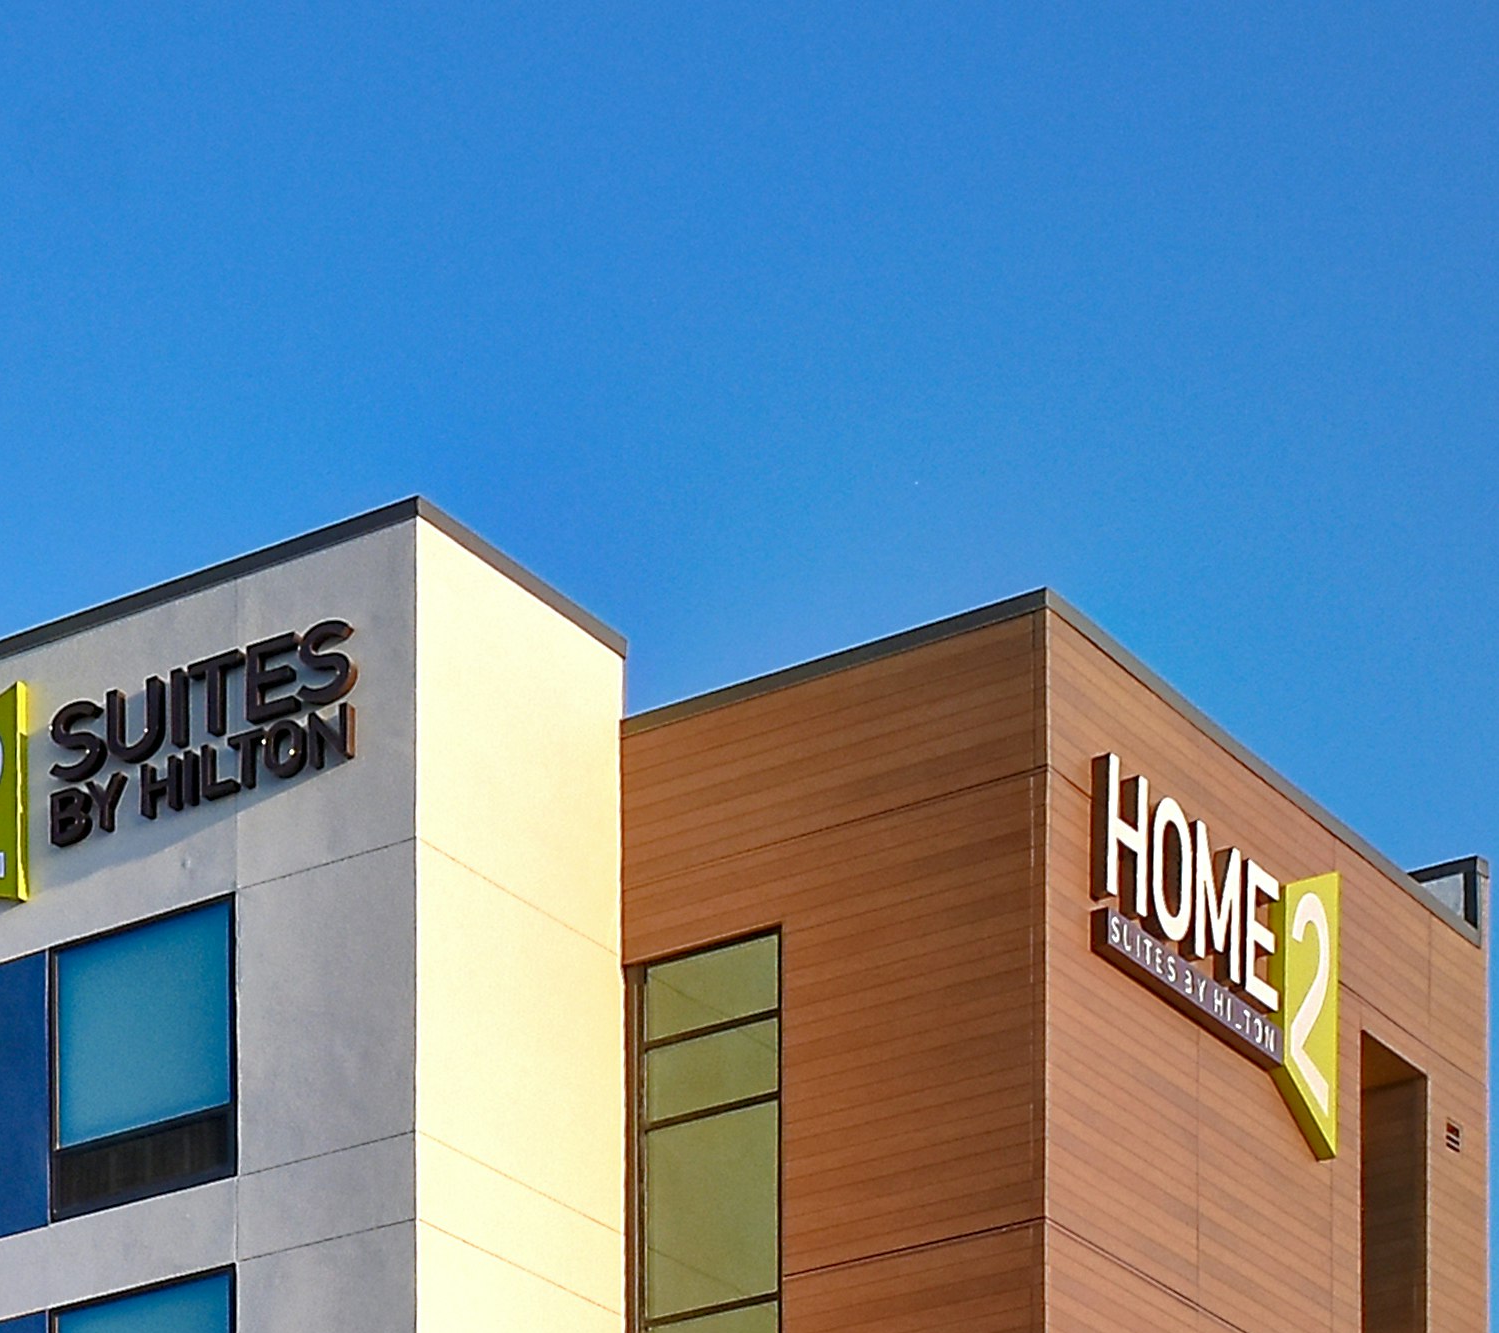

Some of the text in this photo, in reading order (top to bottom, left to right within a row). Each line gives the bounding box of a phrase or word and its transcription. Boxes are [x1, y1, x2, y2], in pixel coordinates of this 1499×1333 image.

[49, 618, 358, 783] SUITES
[50, 702, 356, 849] BY HILTON
[1095, 753, 1330, 1119] HOME 2
[1111, 915, 1177, 983] SUITES
